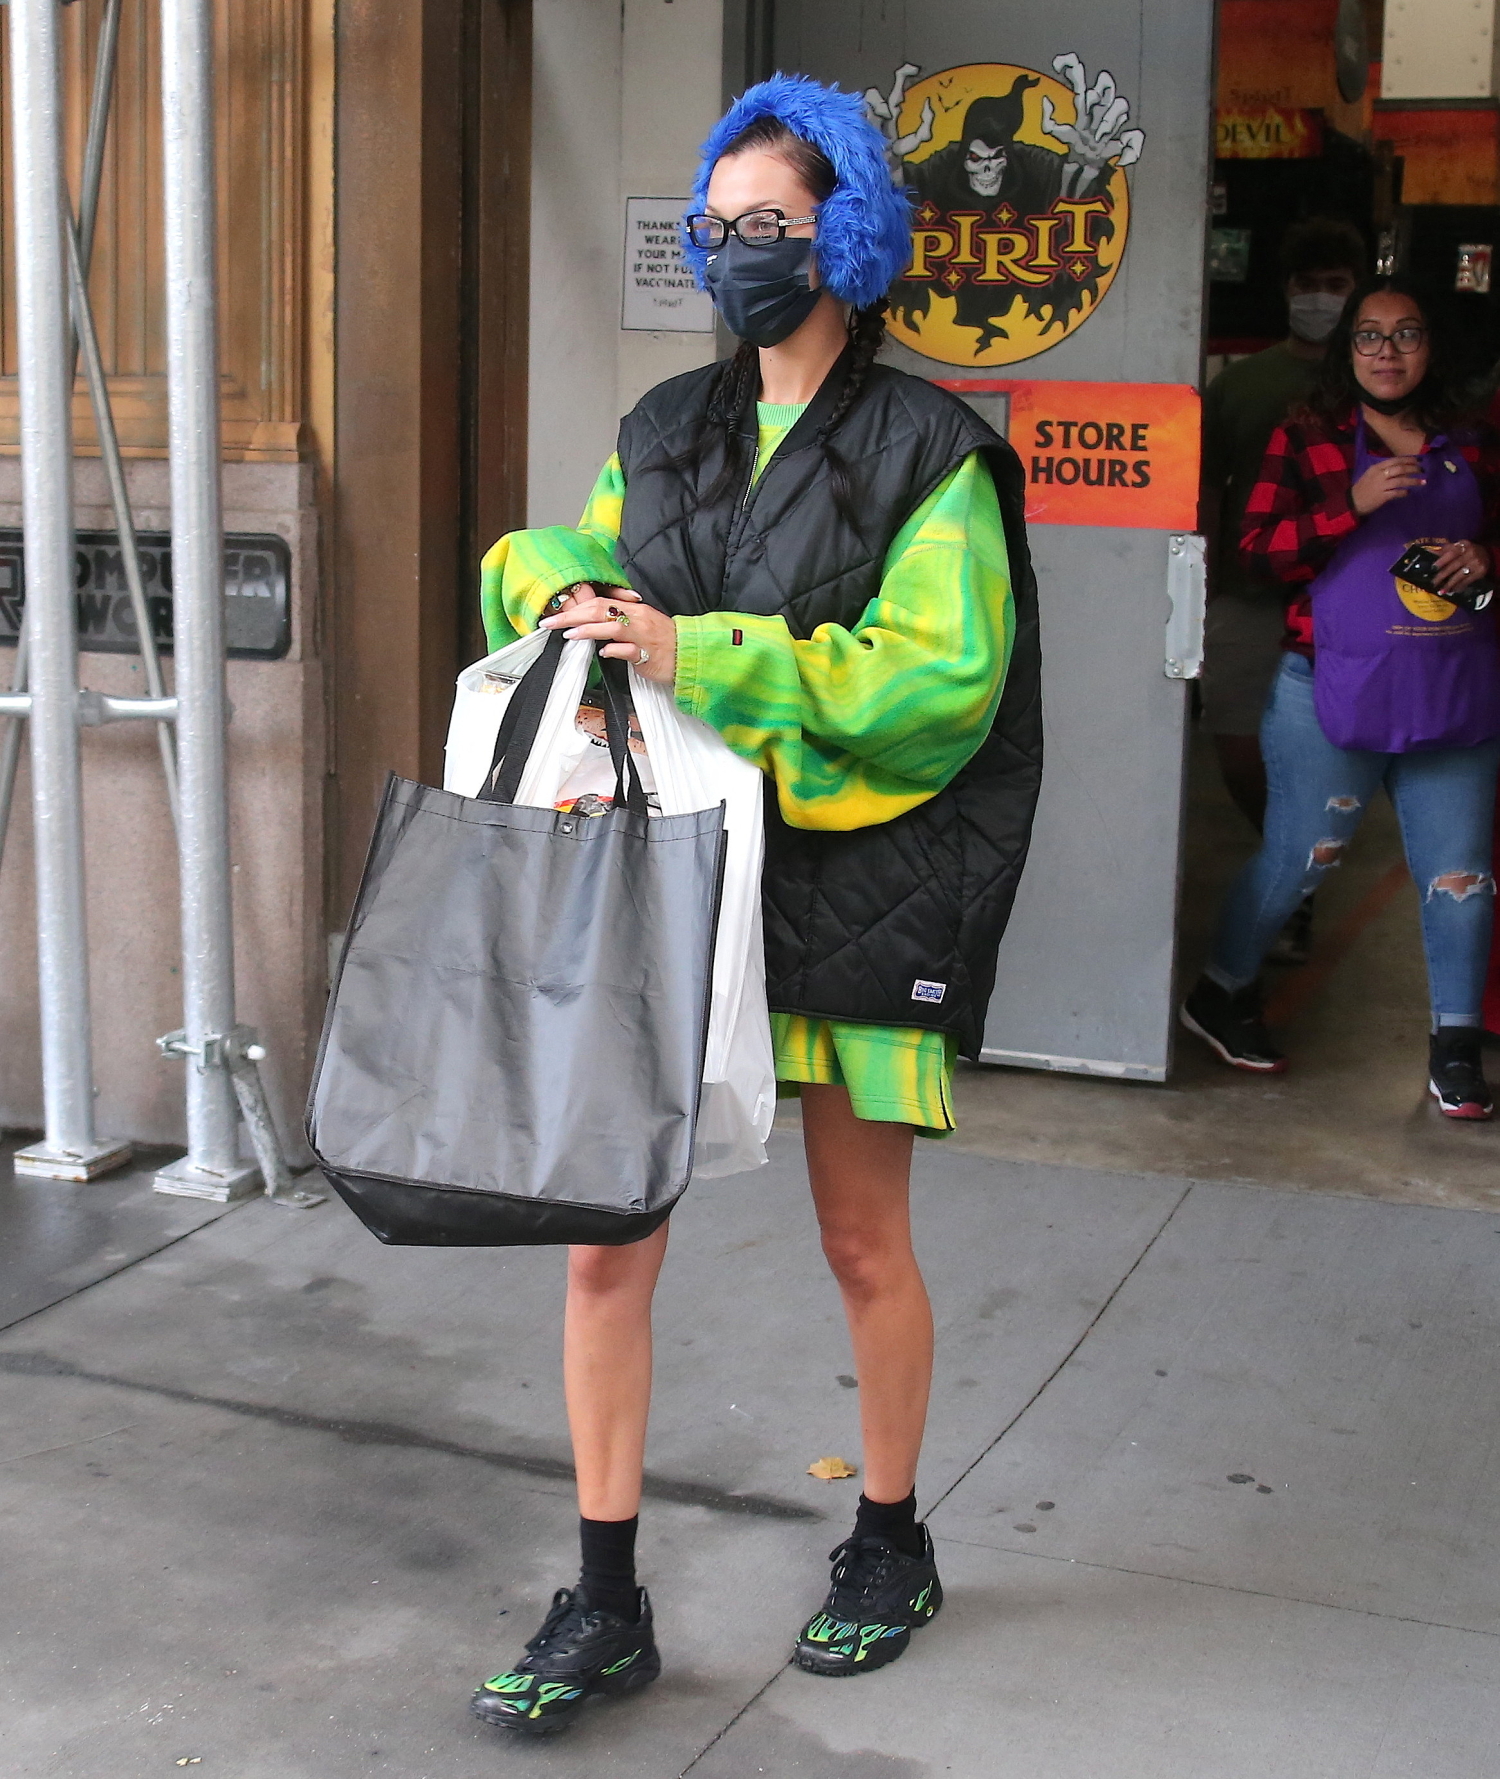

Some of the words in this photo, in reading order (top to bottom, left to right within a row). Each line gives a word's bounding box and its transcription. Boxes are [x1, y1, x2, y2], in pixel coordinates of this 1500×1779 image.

[902, 198, 1112, 286] PIRIT
[637, 249, 667, 259] YOUR
[671, 250, 686, 259] M
[633, 263, 643, 273] IF
[646, 264, 669, 273] NOT
[635, 278, 695, 288] VACCINATE
[1034, 420, 1150, 452] STORE
[1030, 455, 1152, 489] HOURS
